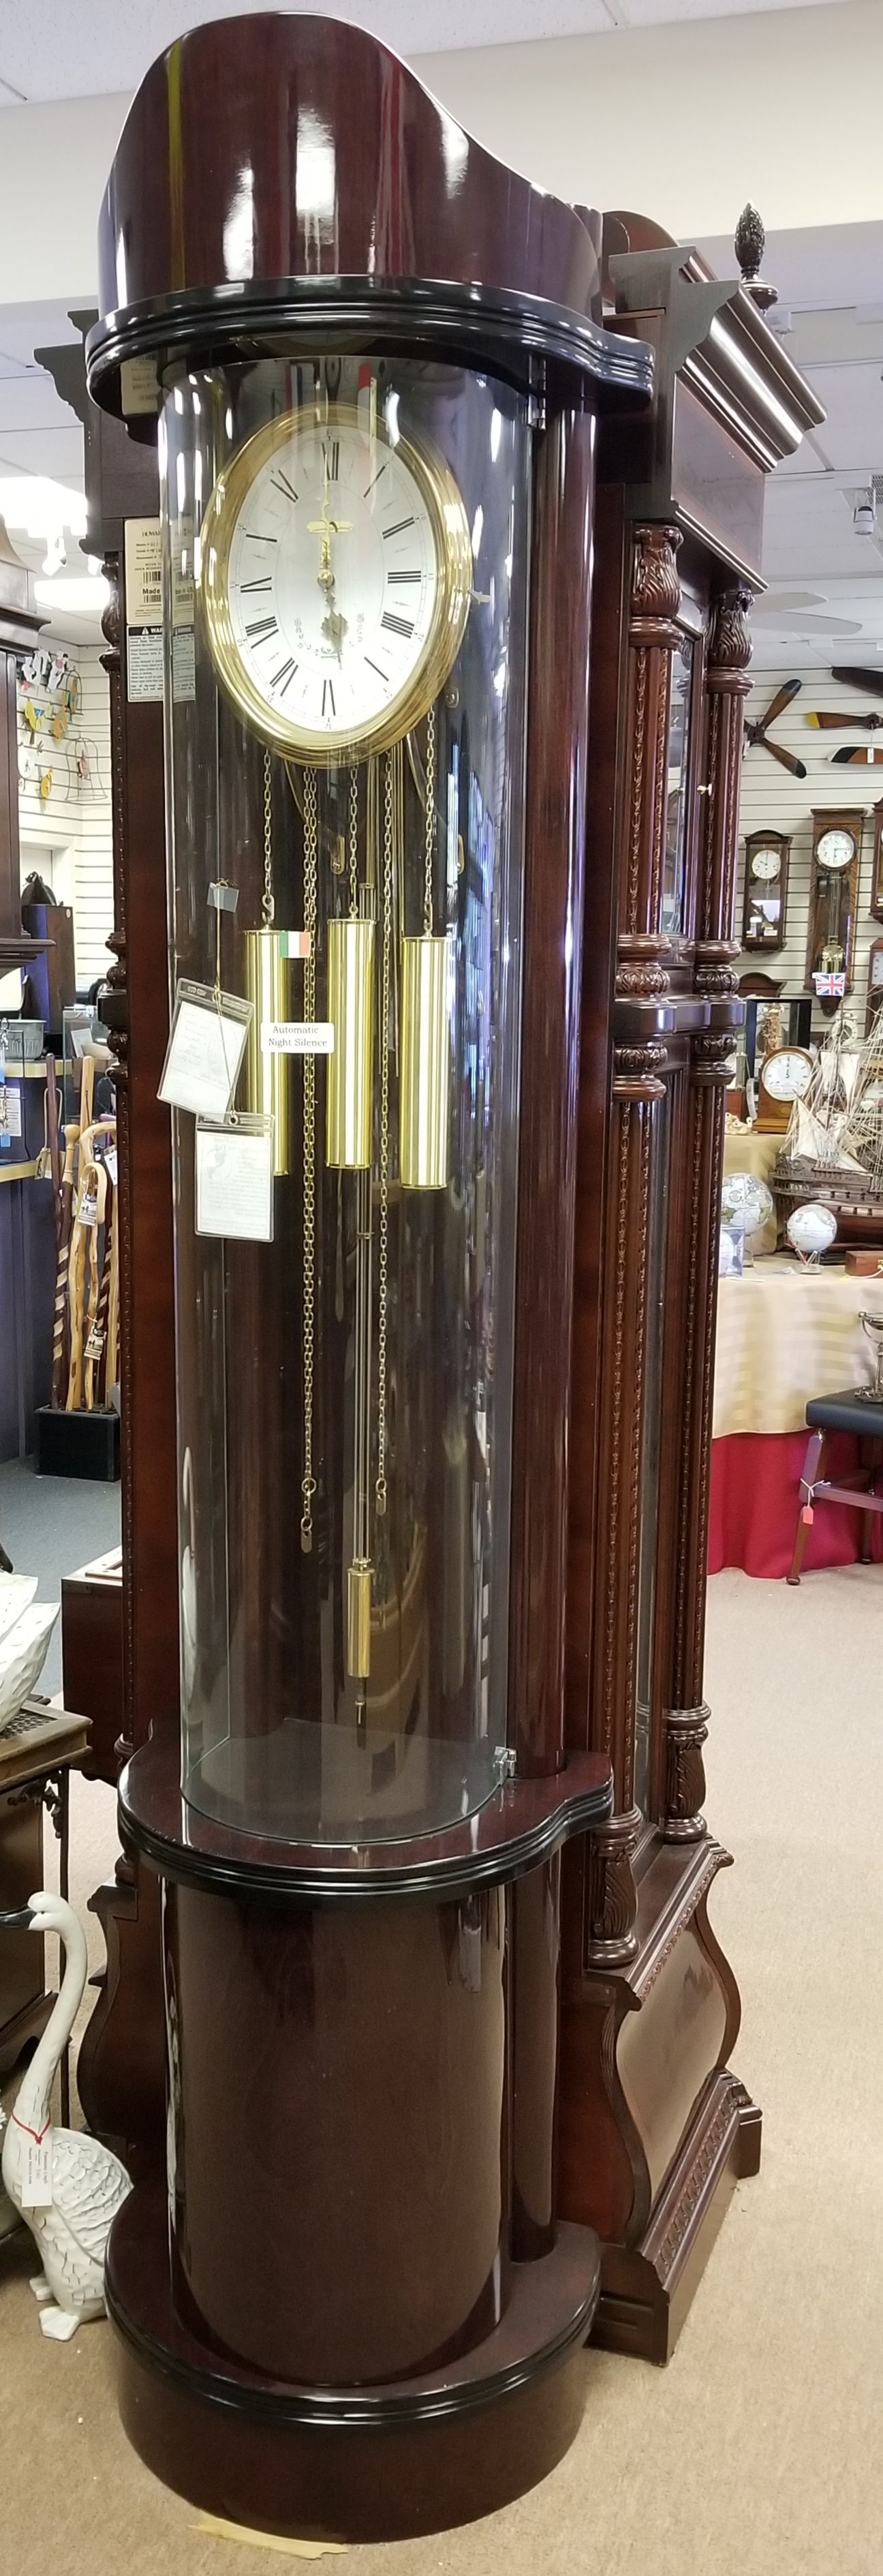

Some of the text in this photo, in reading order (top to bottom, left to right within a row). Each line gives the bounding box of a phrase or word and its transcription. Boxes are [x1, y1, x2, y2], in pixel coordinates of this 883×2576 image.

[273, 1025, 320, 1034] Automatic
[268, 1038, 328, 1048] Night Silence
